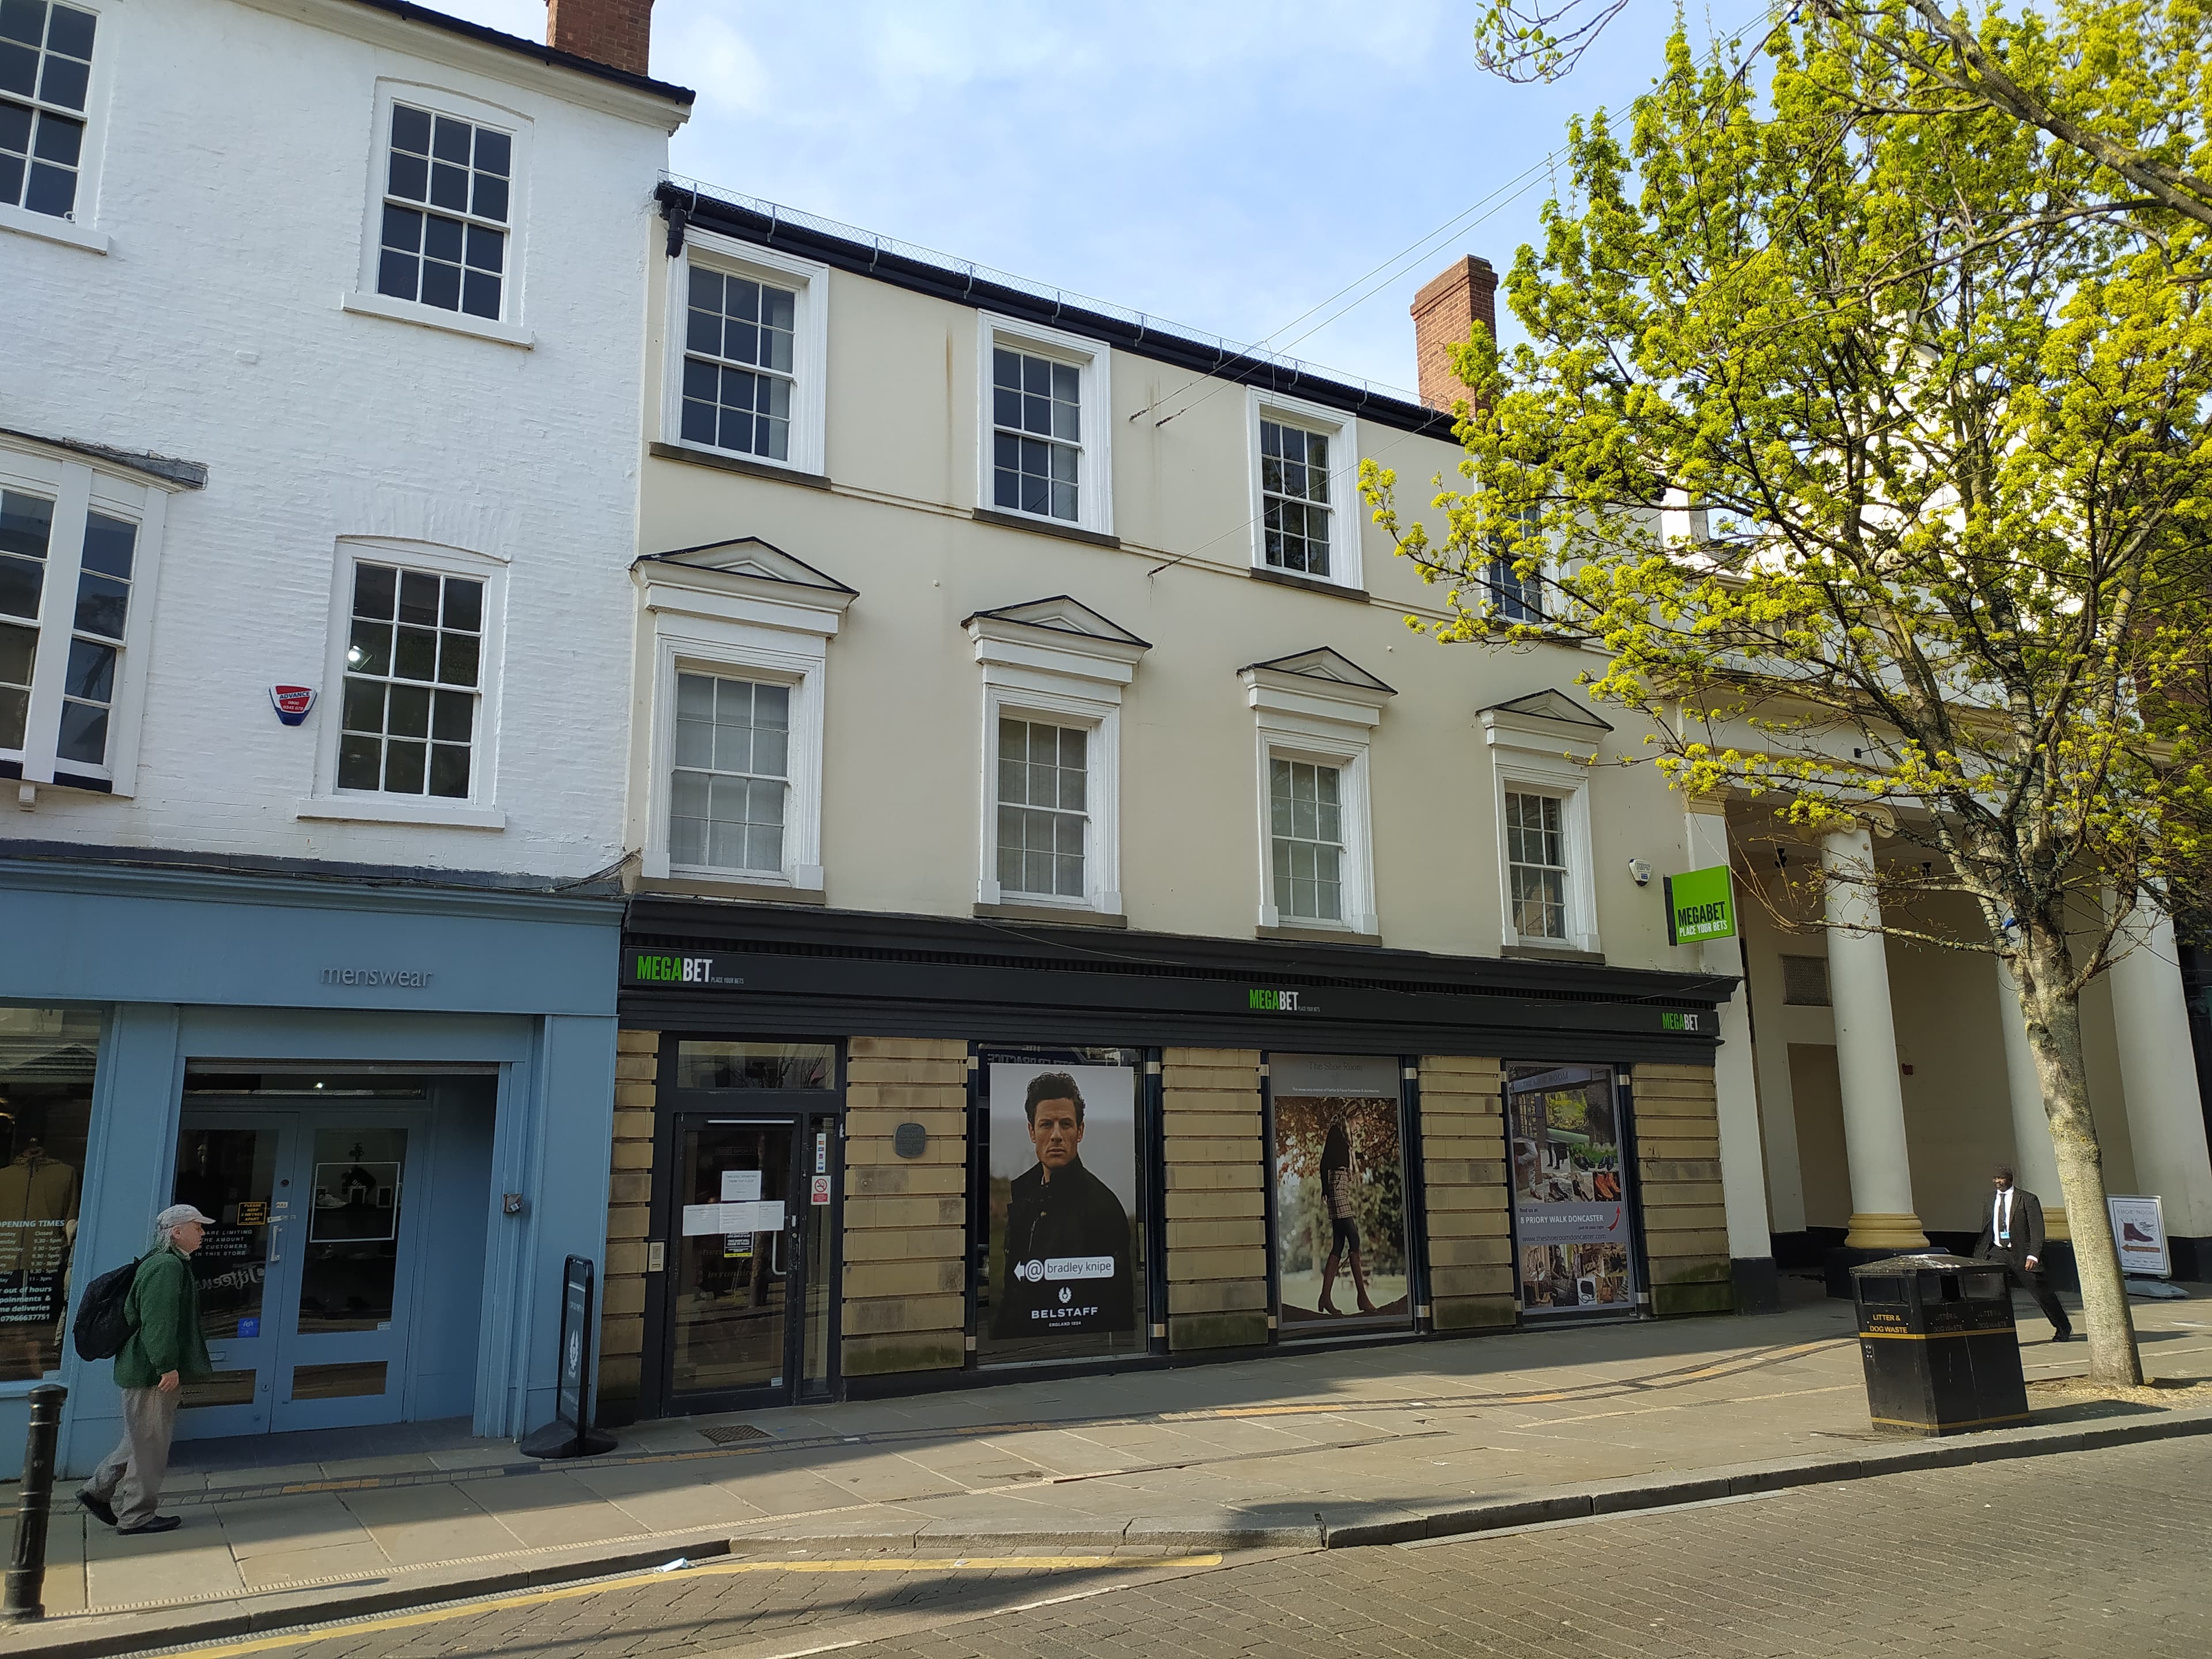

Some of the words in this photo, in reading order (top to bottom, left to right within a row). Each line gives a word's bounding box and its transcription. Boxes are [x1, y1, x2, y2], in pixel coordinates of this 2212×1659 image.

[279, 691, 310, 699] ADVANCE
[1677, 901, 1725, 927] MEGABET
[1679, 925, 1696, 937] PLACE
[1697, 922, 1712, 934] YOUR
[1713, 920, 1728, 931] BETS
[320, 968, 433, 987] menswear
[637, 956, 713, 982] MEGABET
[1249, 989, 1298, 1011] MEGABET
[1662, 1013, 1698, 1031] MEGABET
[1308, 1060, 1323, 1070] The
[1325, 1062, 1342, 1070] Shoe
[1343, 1062, 1363, 1071] Room
[1526, 1216, 1548, 1224] PRIORY
[1568, 1214, 1604, 1222] DONCASTER
[1027, 1262, 1042, 1279] @
[1047, 1262, 1083, 1275] bradley
[1086, 1261, 1111, 1273] knipe
[1, 1314, 50, 1322] 07966637751
[1031, 1306, 1099, 1319] BELSTAFF
